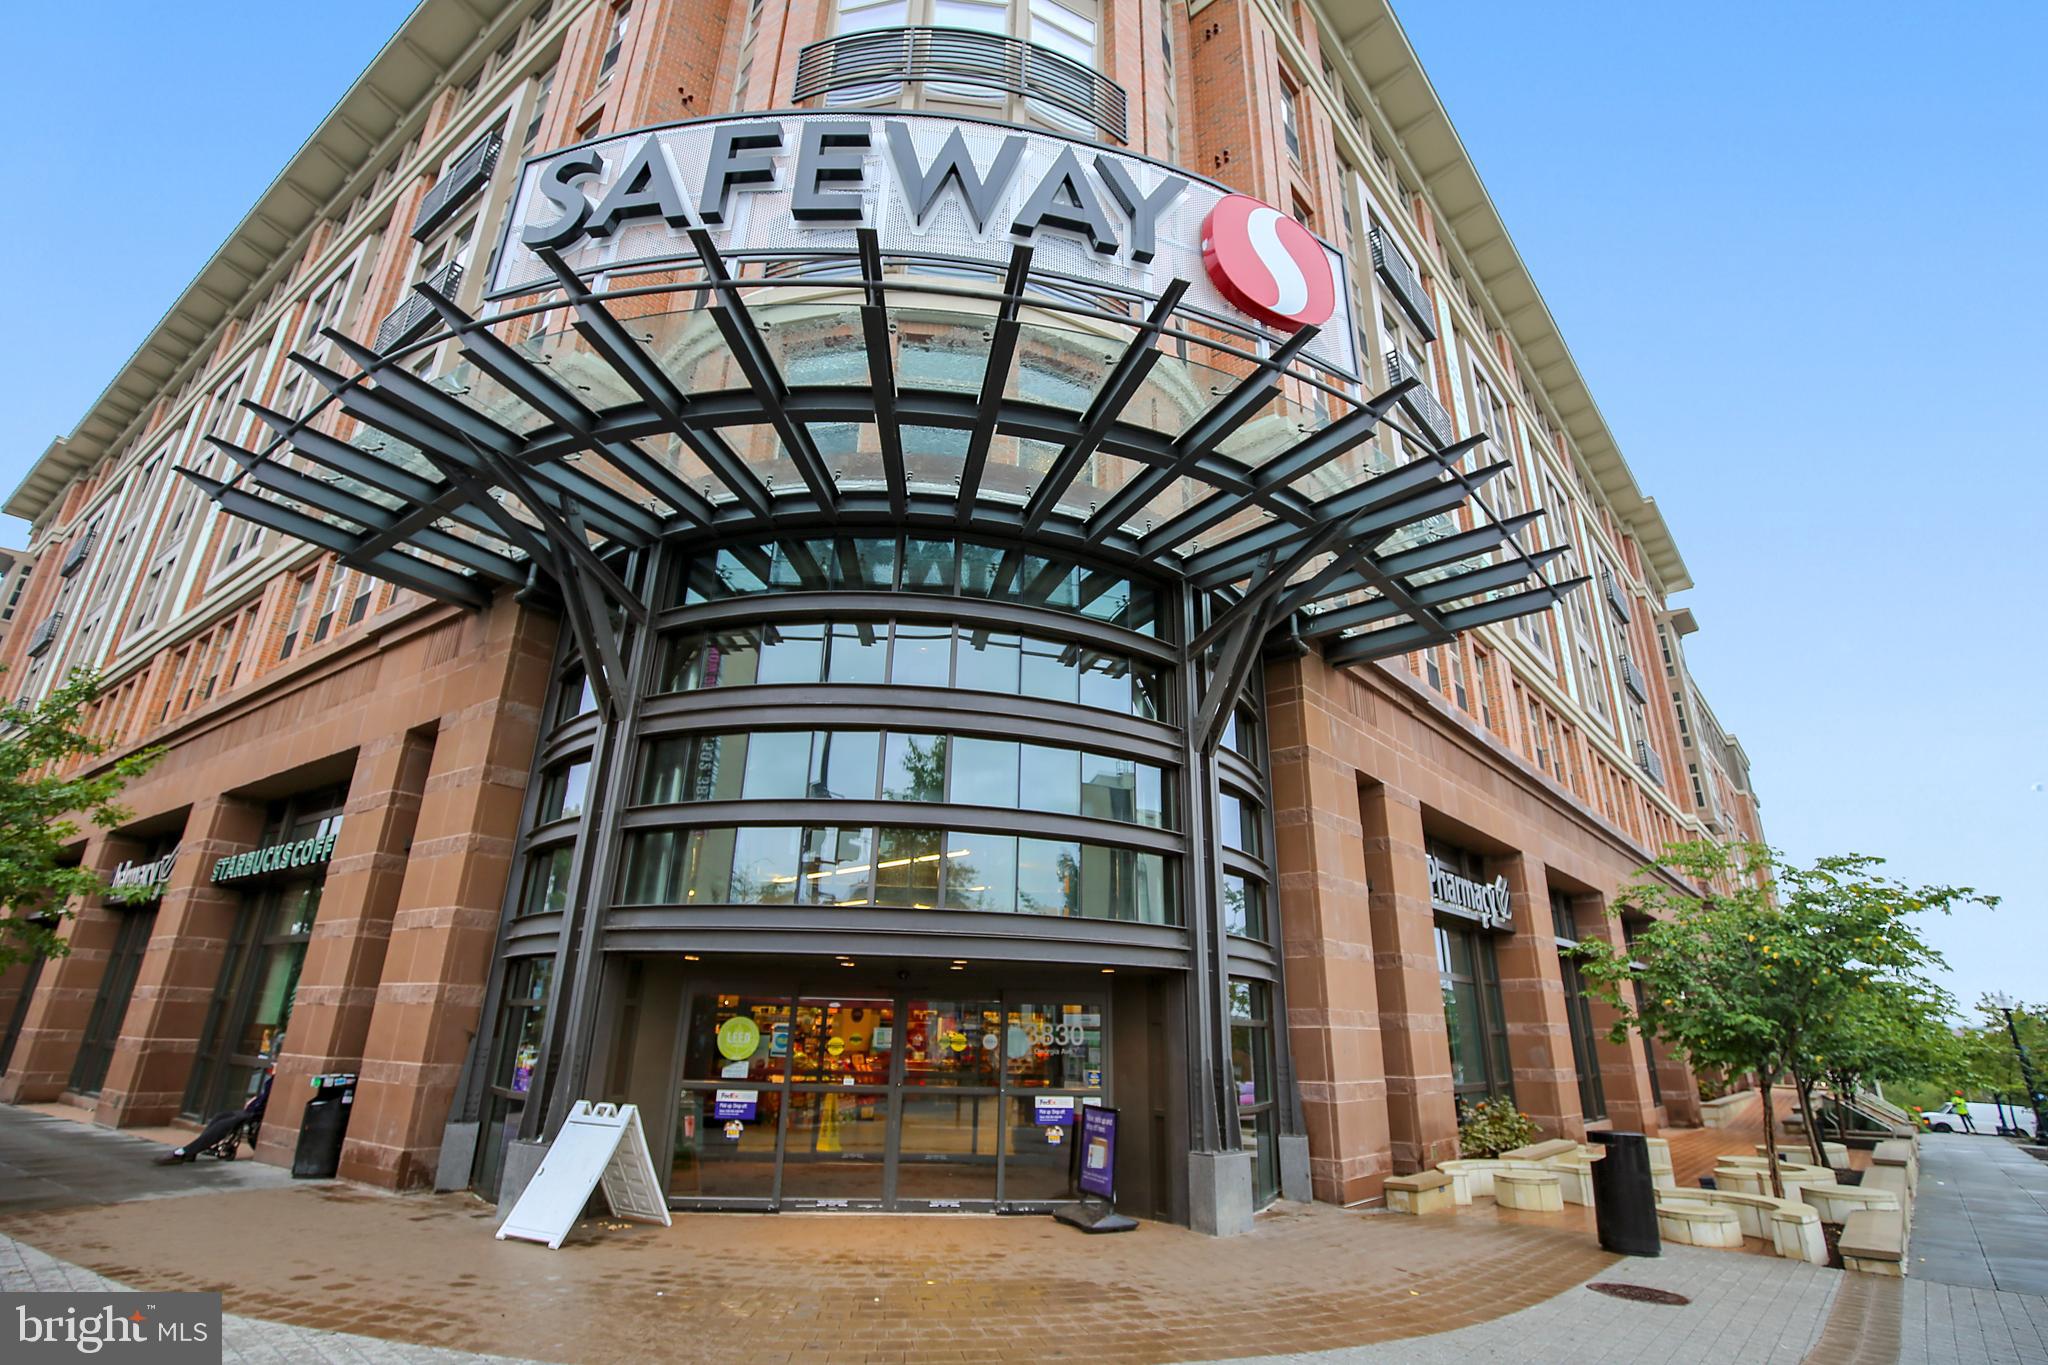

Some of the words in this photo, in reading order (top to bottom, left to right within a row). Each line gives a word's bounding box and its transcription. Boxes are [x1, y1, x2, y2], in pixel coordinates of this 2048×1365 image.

[523, 120, 1189, 264] SAFEWAY
[210, 842, 294, 882] STARBUCKS
[290, 834, 334, 867] COFF
[1425, 853, 1496, 929] Pharmacy
[1026, 1023, 1084, 1046] 3830
